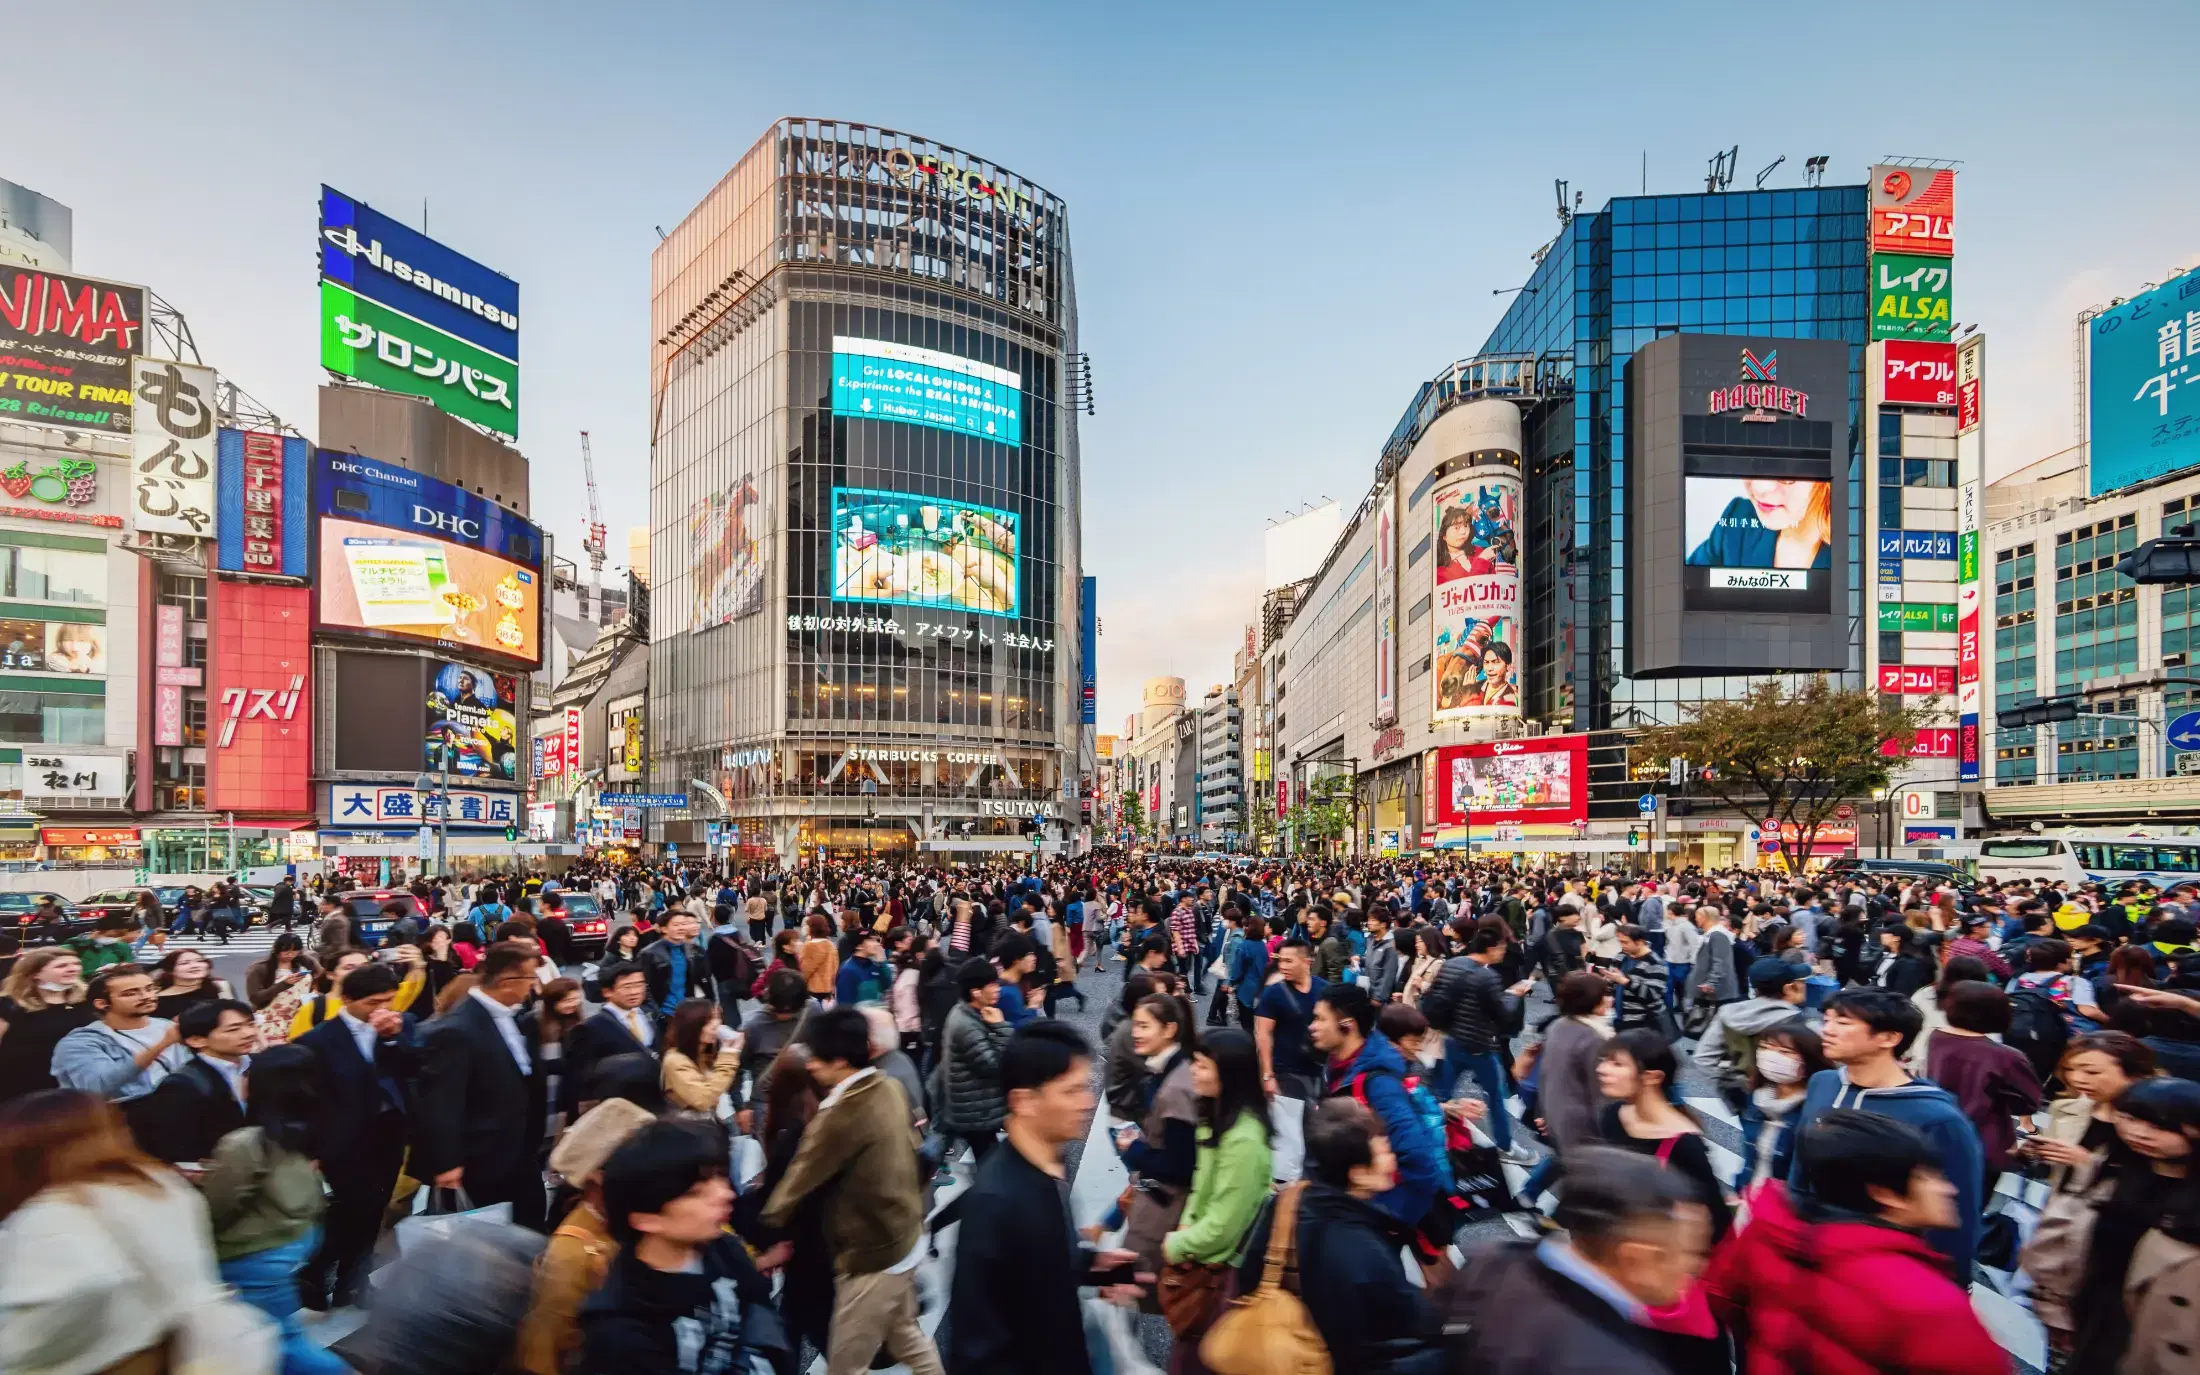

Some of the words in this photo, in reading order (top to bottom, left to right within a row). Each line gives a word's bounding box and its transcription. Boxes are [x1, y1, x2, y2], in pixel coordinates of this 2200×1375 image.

[1885, 212, 1955, 239] アコム
[324, 227, 518, 331] Hisamitsu
[1879, 264, 1948, 293] レイク
[1877, 295, 1949, 321] ALSA
[335, 314, 512, 410] サロンパス
[1887, 359, 1954, 383] アイフル
[12, 373, 75, 399] TOUR
[863, 365, 885, 377] Get
[886, 367, 931, 385] LOCAL
[931, 376, 982, 396] GUIDES
[838, 377, 901, 395] Experience
[905, 383, 923, 397] the
[924, 388, 959, 405] REAL
[960, 396, 1016, 420] SHIBUYA
[1710, 383, 1809, 418] MAGNET
[1936, 391, 1954, 404] 8F
[1963, 391, 1976, 427] アイフル
[923, 409, 957, 425] Japan
[137, 363, 212, 533] もんじゃ
[332, 460, 362, 475] DHC
[364, 467, 418, 487] Channel
[243, 434, 275, 566] 三千里薬品
[1964, 485, 1974, 531] レオパレス21
[412, 504, 479, 539] DHC
[1880, 537, 1951, 555] レオパレス21
[1964, 534, 1974, 553] レイク
[1727, 574, 1790, 588] みんなのFX
[1879, 610, 1901, 619] レイク
[1903, 611, 1929, 620] ALSA
[1962, 630, 1976, 663] アコム
[1885, 672, 1933, 688] アコム
[217, 674, 306, 748] クスリ
[446, 708, 499, 729] Planets
[454, 702, 487, 716] teamLab
[849, 749, 938, 762] STARBUCKS
[946, 752, 998, 765] COFFEE
[1493, 742, 1525, 756] Glico
[1909, 743, 1928, 754] 入口
[1963, 725, 1975, 763] PROMISE
[342, 792, 512, 820] 大盛堂書店
[982, 801, 1053, 817] TSUTAYA
[1906, 793, 1929, 815] 0円
[1907, 831, 1938, 840] PROMISE
